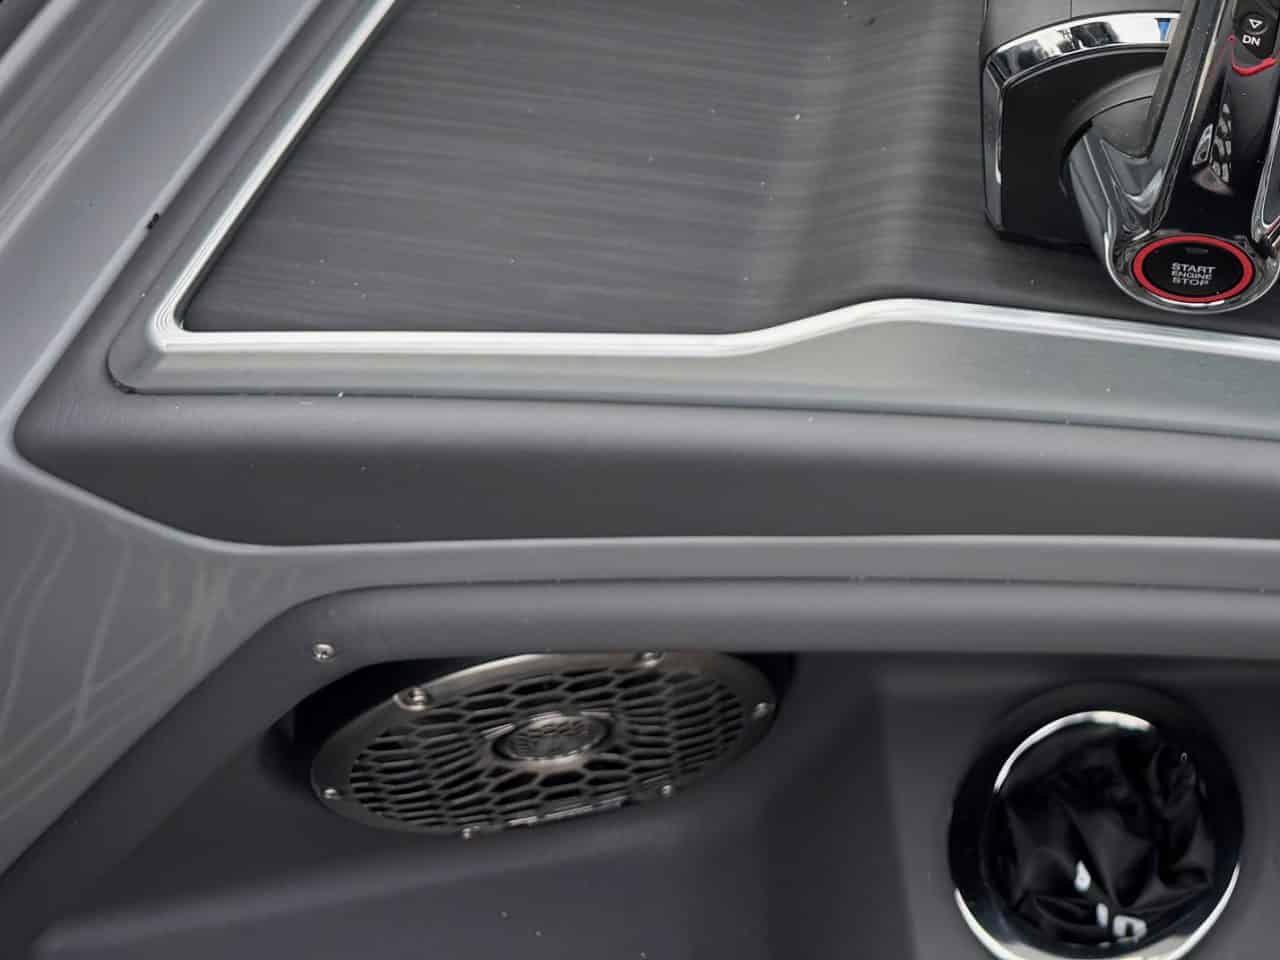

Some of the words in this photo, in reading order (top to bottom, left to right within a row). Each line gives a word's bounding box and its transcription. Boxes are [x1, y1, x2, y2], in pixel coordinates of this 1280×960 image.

[1242, 34, 1261, 46] DN
[1171, 262, 1216, 274] START
[1171, 271, 1213, 280] ENGINE
[1172, 277, 1209, 286] STOP
